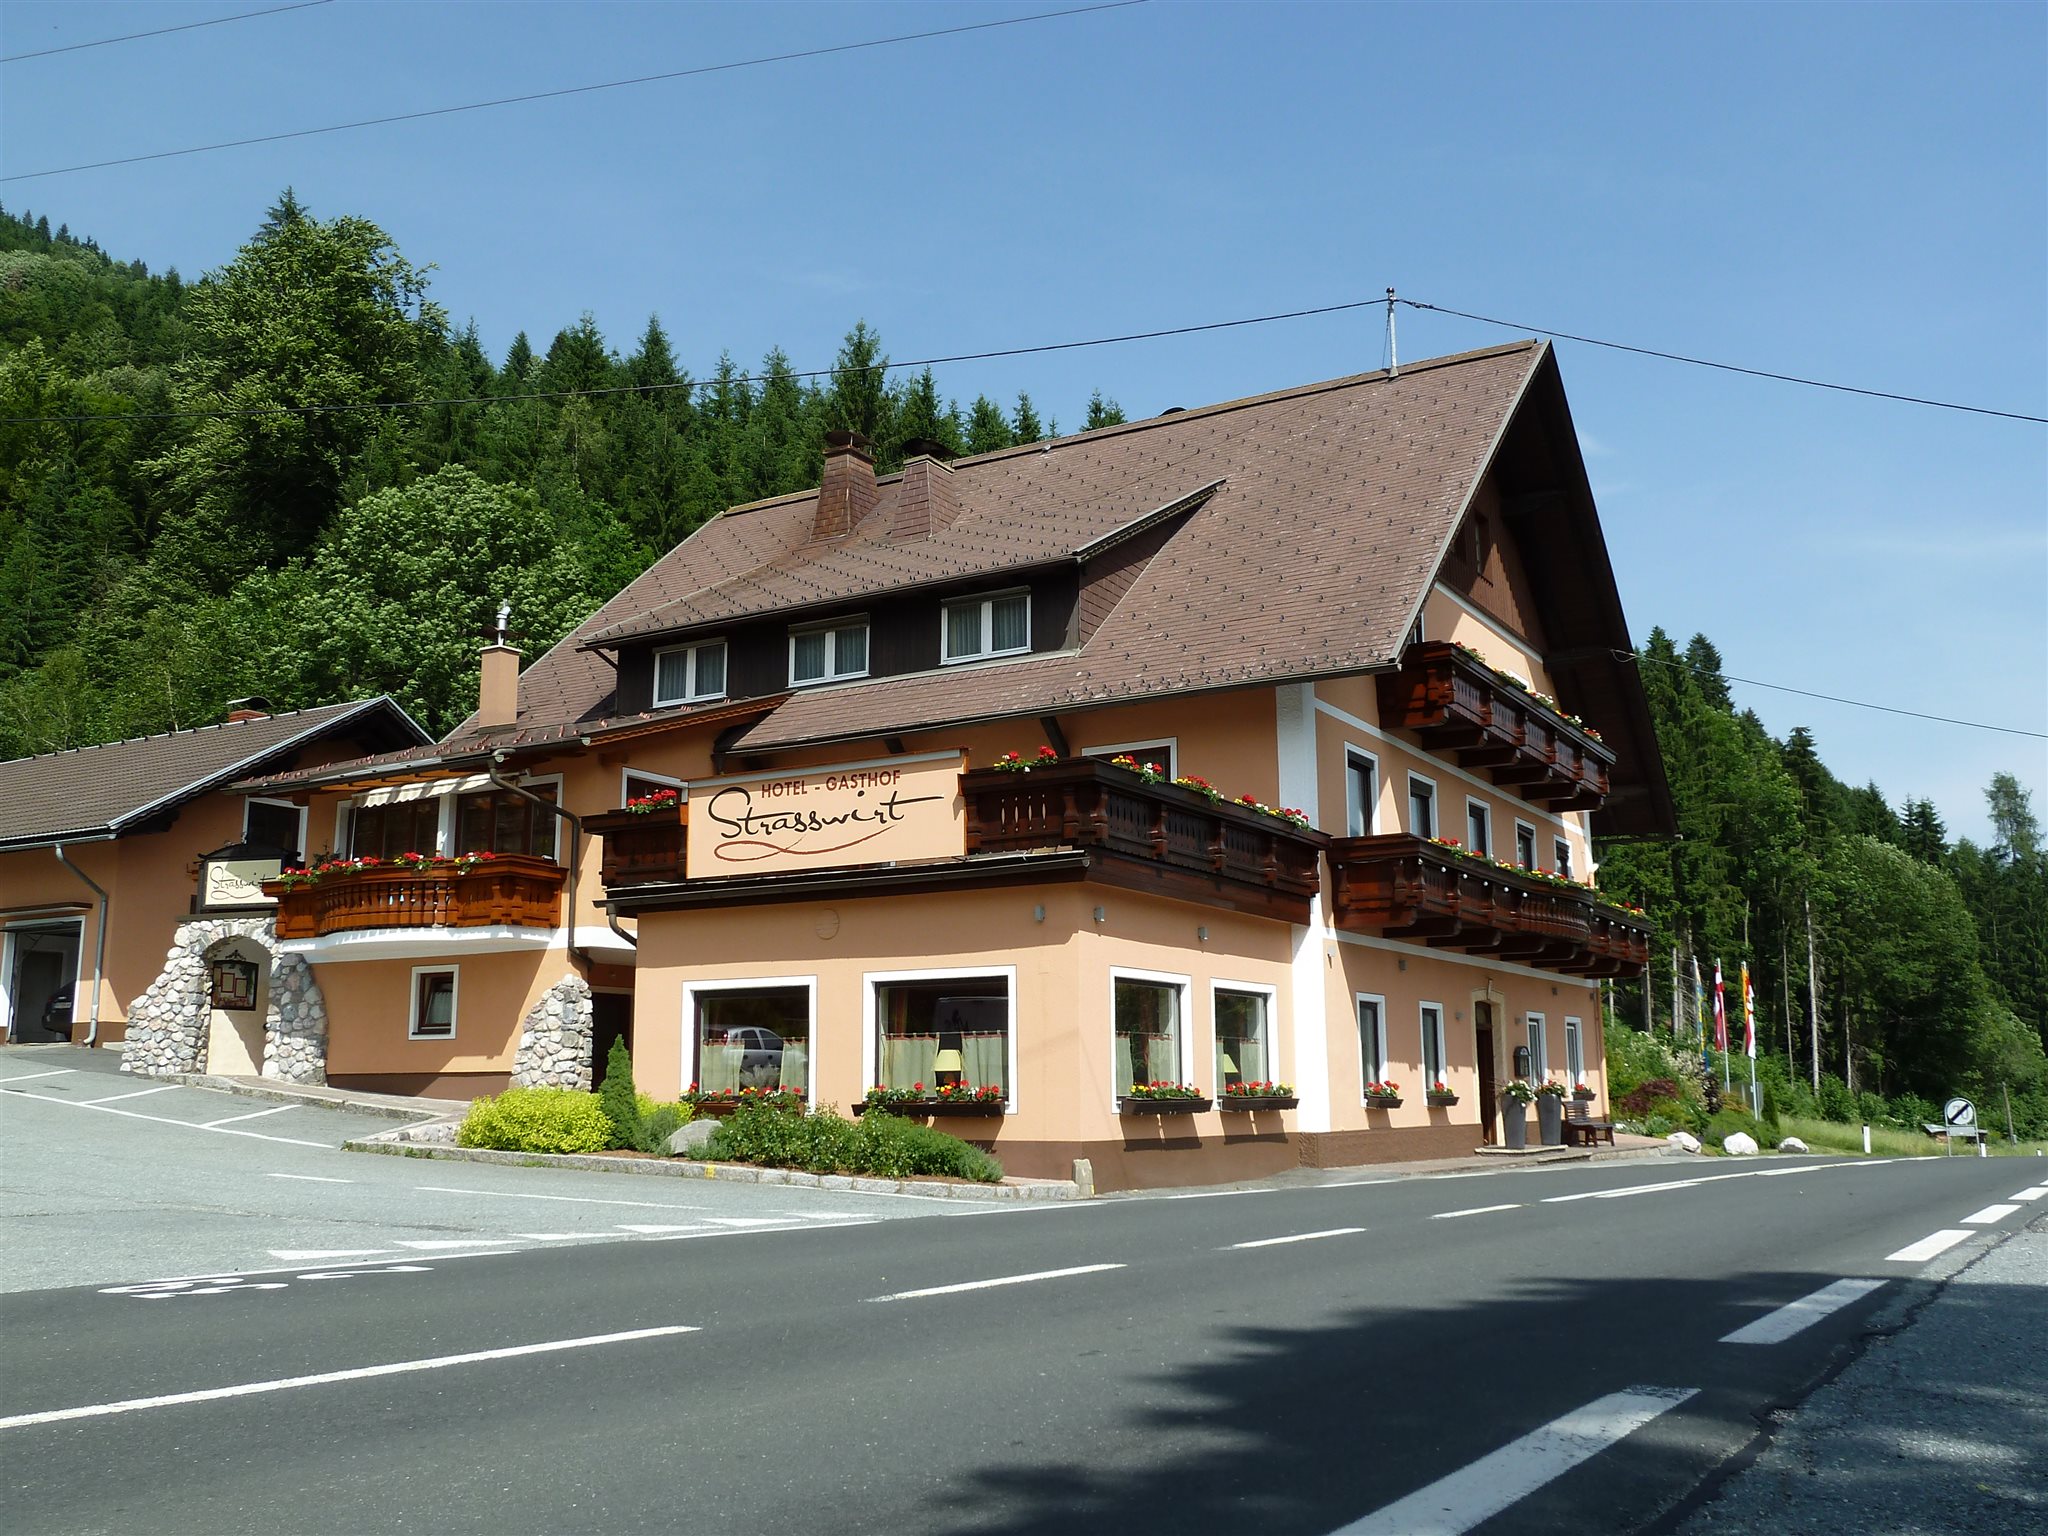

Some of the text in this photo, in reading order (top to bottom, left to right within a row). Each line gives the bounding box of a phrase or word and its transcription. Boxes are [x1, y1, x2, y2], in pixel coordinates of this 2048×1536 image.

[761, 780, 808, 798] HOTEL
[826, 770, 901, 791] GASTHOF
[708, 786, 945, 839] Strasswirt
